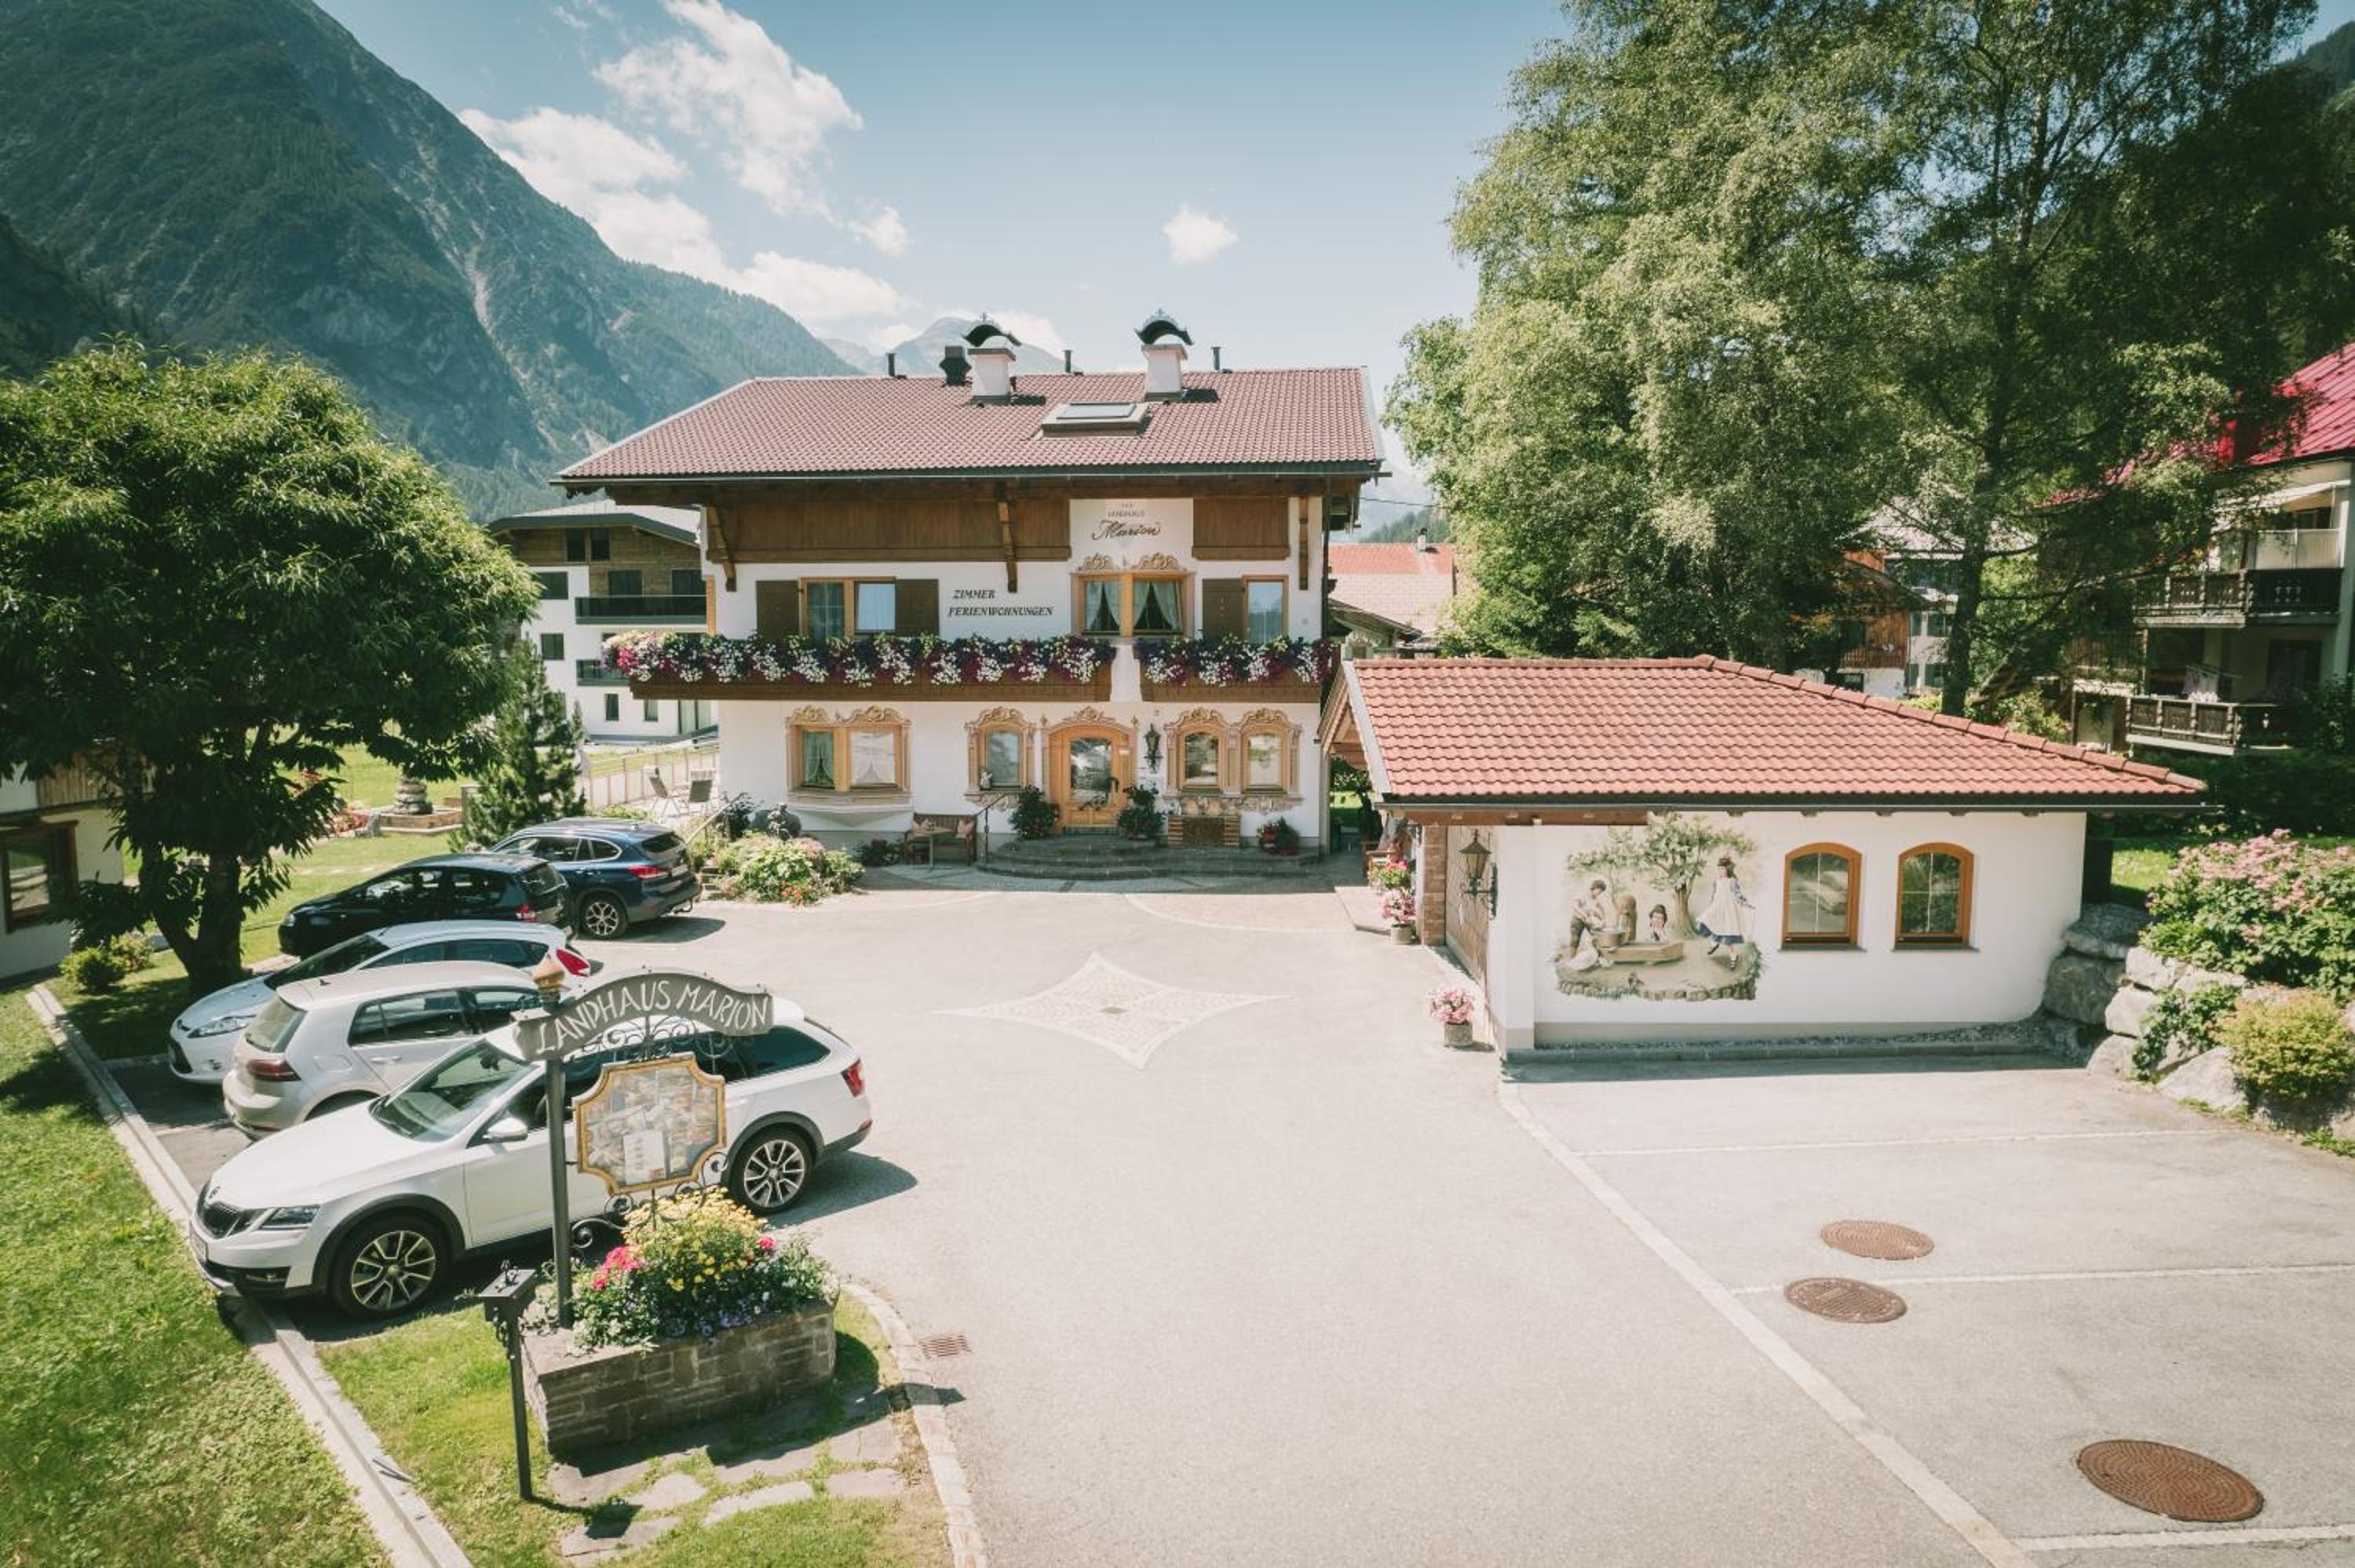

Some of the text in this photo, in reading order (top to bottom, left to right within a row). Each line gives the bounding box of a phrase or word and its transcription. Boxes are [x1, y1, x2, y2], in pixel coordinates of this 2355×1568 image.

[1092, 520, 1161, 541] Marion
[953, 589, 995, 599] ZIMMER
[947, 606, 1053, 617] FERIENWOHNUNGEN
[535, 981, 769, 1054] LANDHAUS MARION
